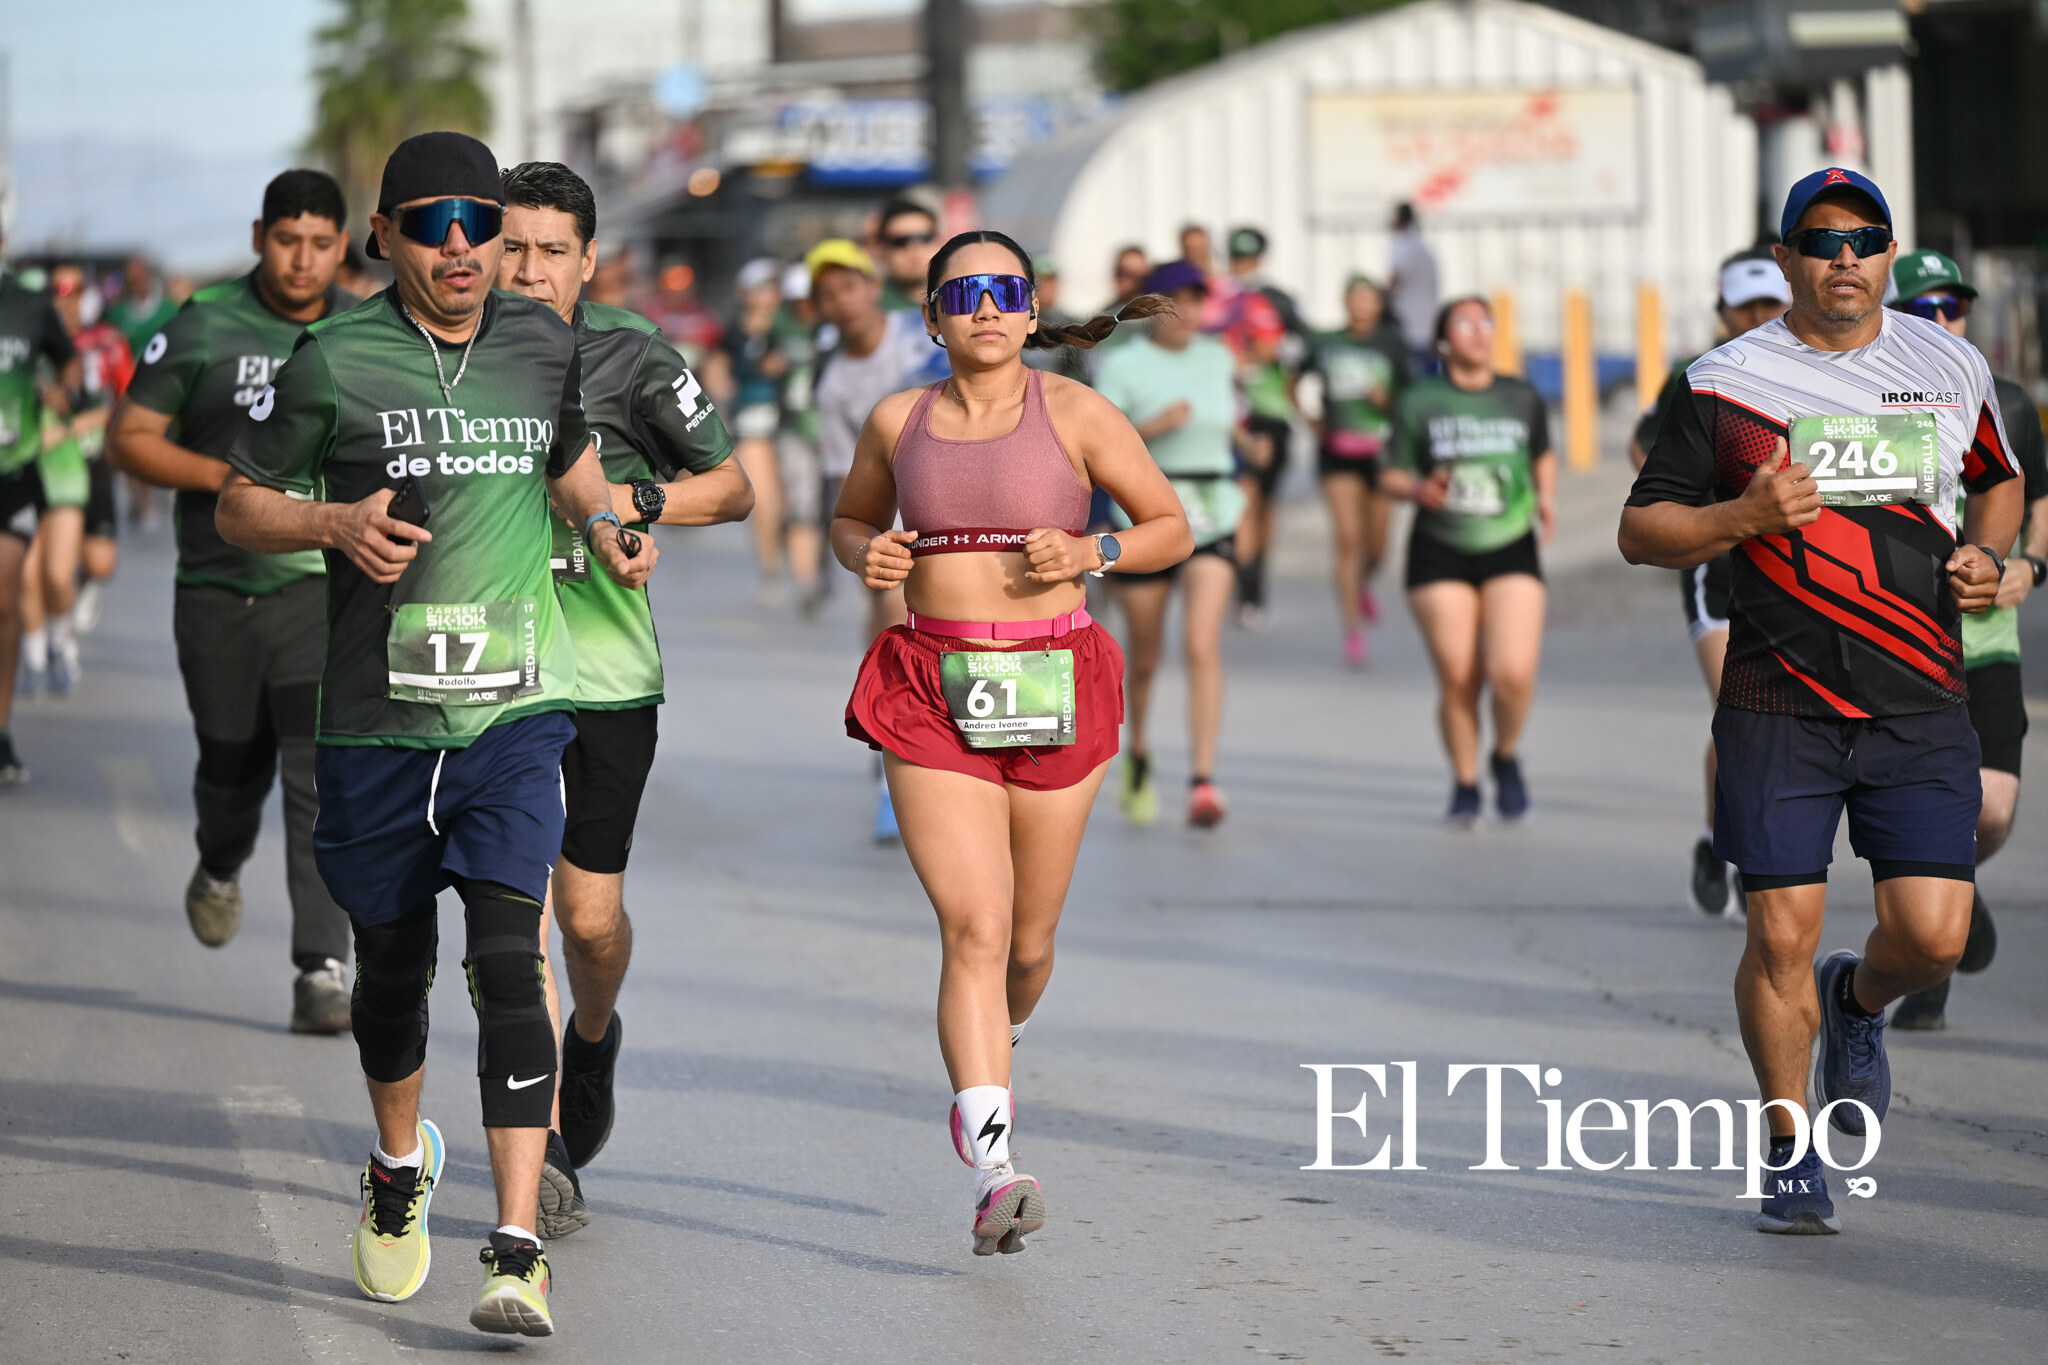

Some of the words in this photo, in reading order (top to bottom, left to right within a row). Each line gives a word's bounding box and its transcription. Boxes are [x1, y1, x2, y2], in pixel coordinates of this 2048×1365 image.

[237, 355, 269, 386] El
[1881, 392, 1961, 404] IRONCAST
[376, 408, 425, 449] El
[426, 408, 553, 452] Tiempo
[1823, 417, 1878, 425] CARRERA
[1916, 420, 1934, 428] 246
[386, 453, 431, 480] de
[436, 450, 534, 476] todos
[1809, 440, 1898, 477] 246
[1921, 434, 1935, 494] MEDALLA
[426, 605, 487, 615] CARRERA
[524, 603, 534, 613] 17
[427, 632, 490, 673] 17
[525, 619, 536, 687] MEDALLA
[968, 654, 1021, 662] CARRERA
[1060, 656, 1069, 665] 61
[438, 677, 476, 686] Rodolfo
[967, 679, 1017, 718] 61
[1062, 671, 1072, 734] MEDALLA
[964, 721, 996, 730] Andrea
